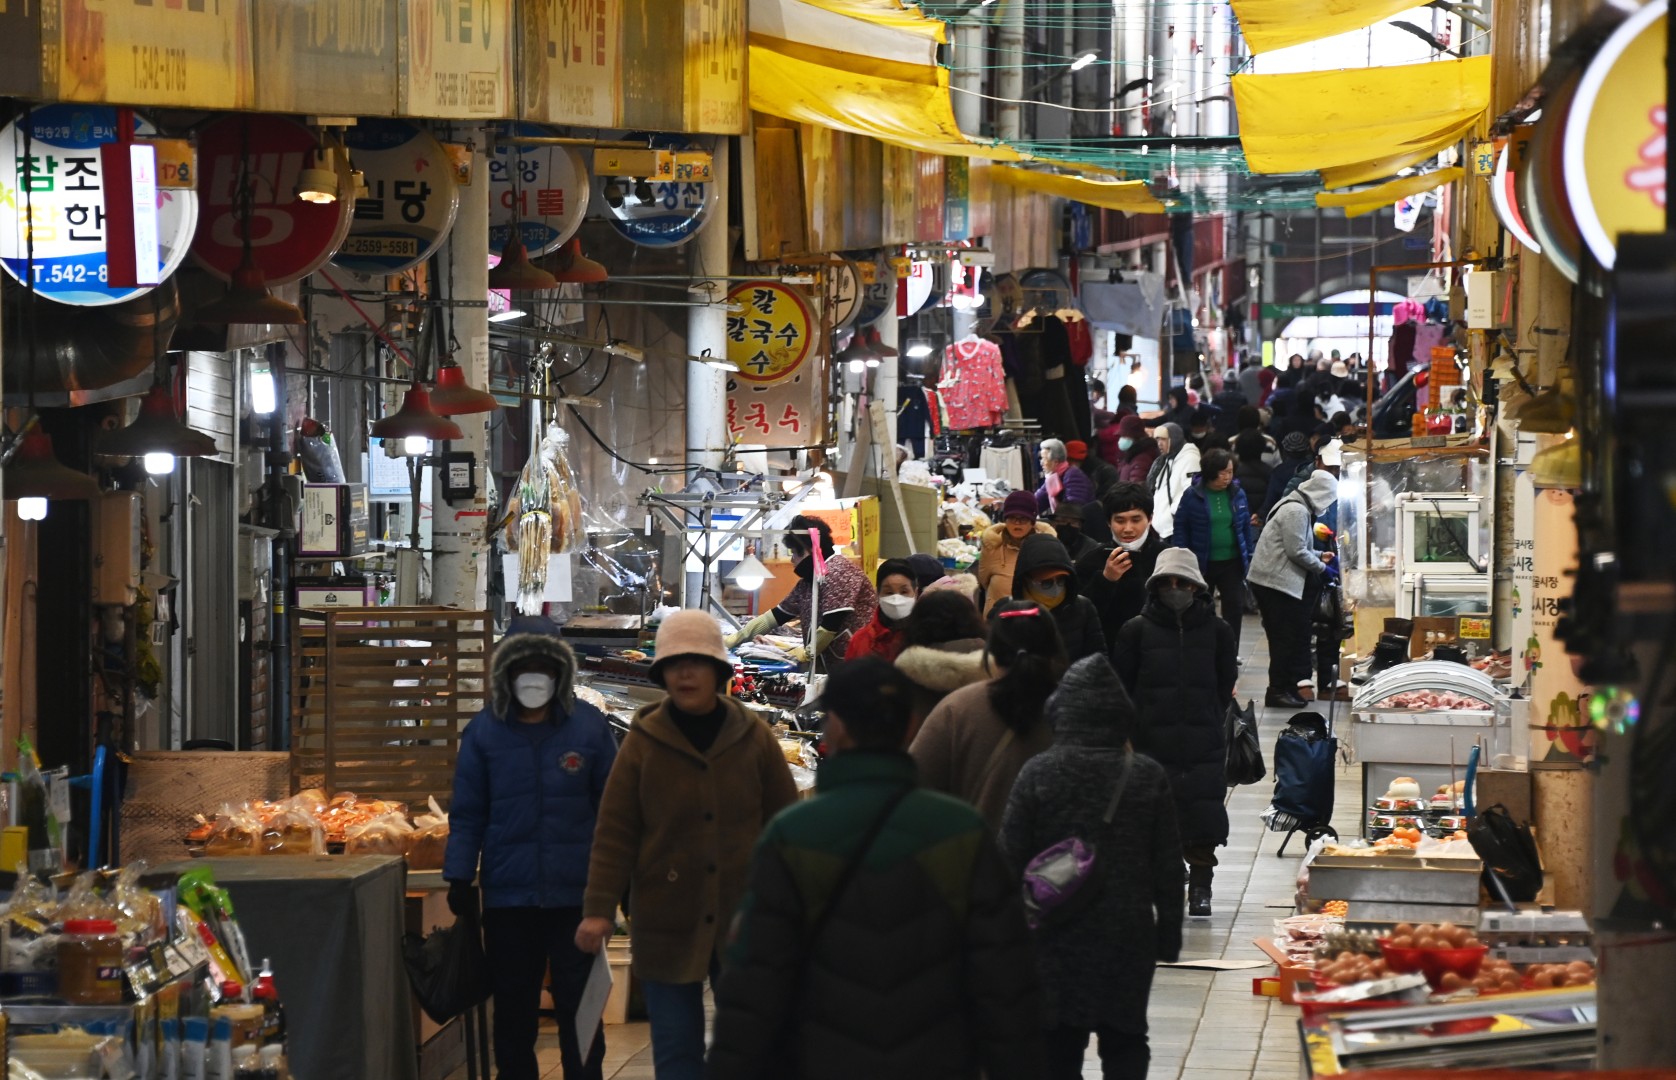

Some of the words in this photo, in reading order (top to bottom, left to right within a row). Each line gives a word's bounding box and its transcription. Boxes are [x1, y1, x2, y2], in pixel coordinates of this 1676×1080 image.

[34, 126, 71, 138] 반송2동
[92, 126, 118, 138] 큰시
[16, 155, 101, 192] 참조
[489, 160, 539, 183] 언양
[354, 179, 432, 223] 일당
[489, 189, 564, 216] 어물
[19, 203, 107, 242] 참한
[341, 239, 415, 254] 0-2559-5581
[32, 264, 108, 283] T.542-8
[727, 317, 799, 346] 칼국수
[1531, 597, 1561, 617] 시장
